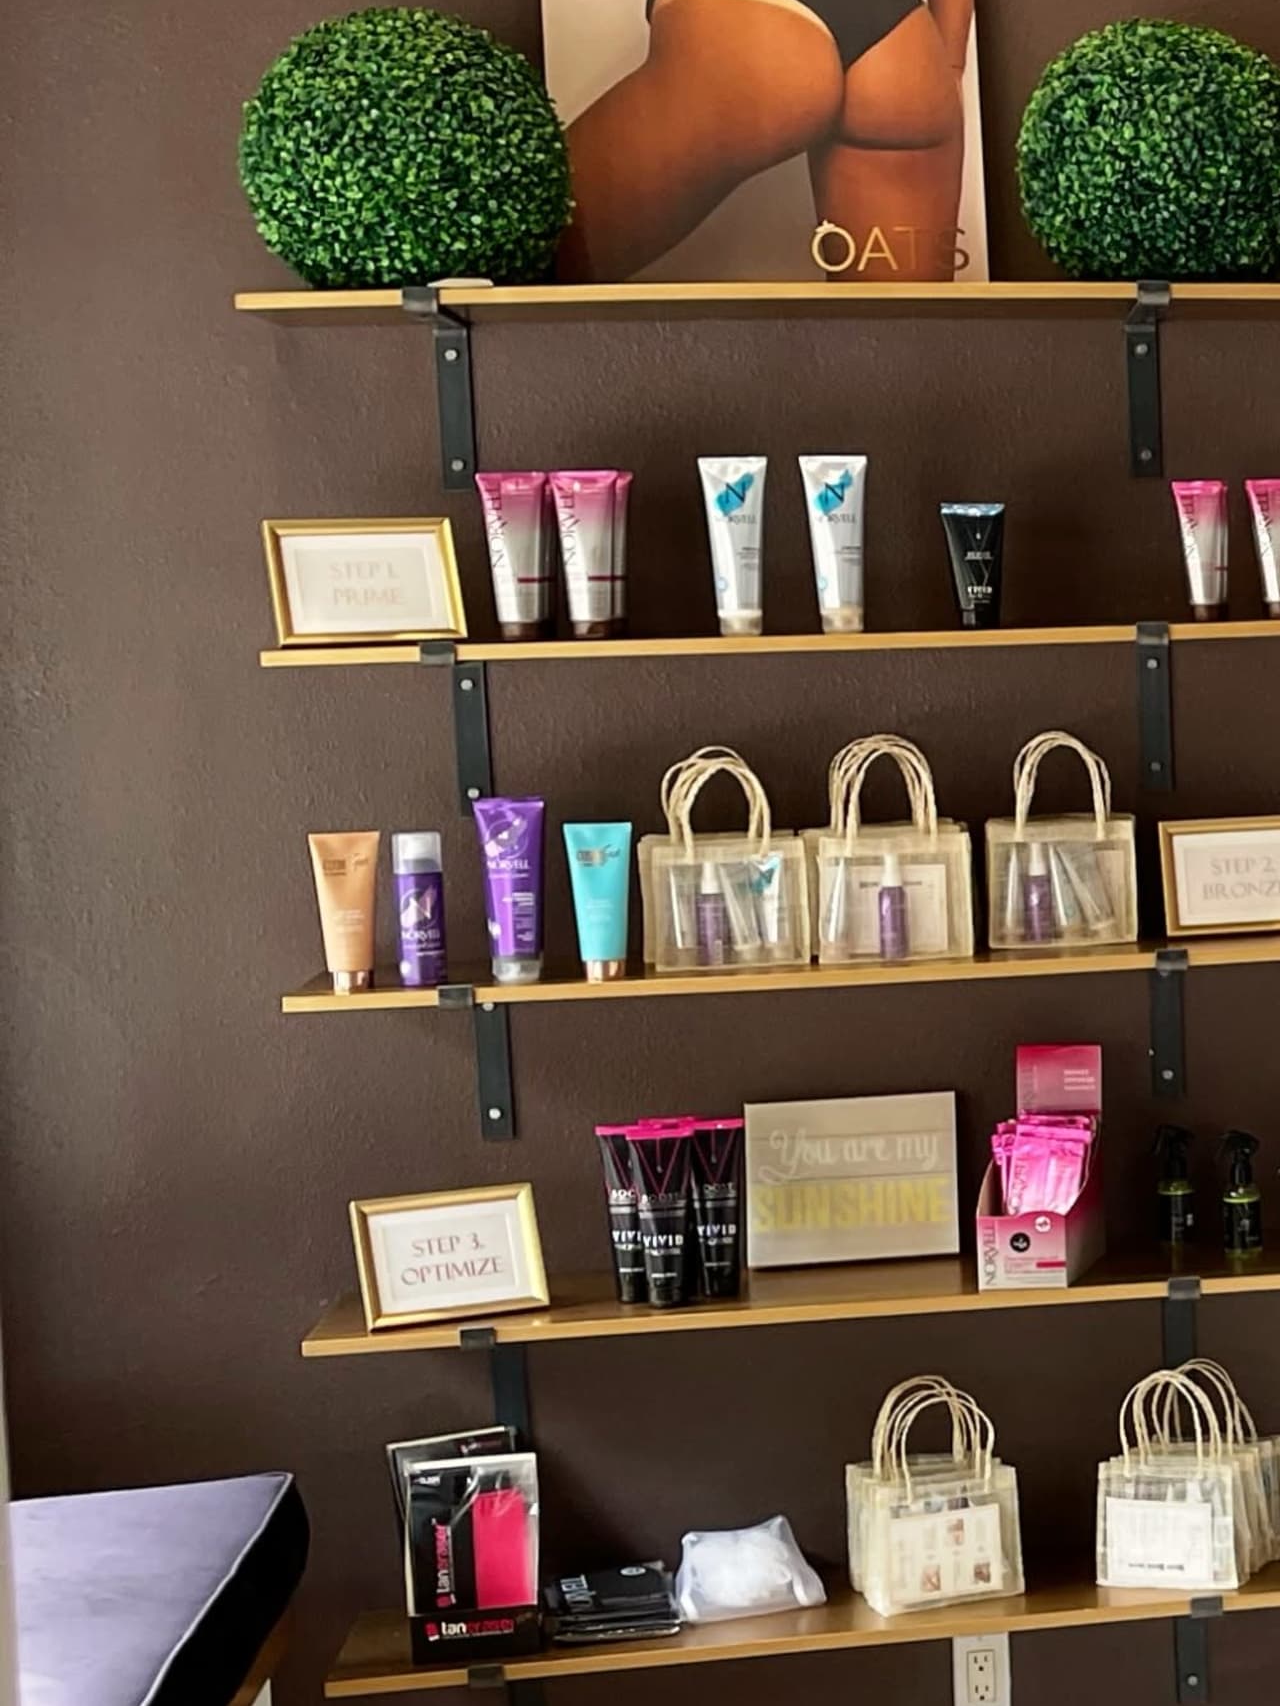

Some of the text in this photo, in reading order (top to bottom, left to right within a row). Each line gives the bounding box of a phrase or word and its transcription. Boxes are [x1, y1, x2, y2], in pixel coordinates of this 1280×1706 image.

[811, 221, 970, 273] OATS
[1209, 856, 1257, 876] STEP
[843, 1138, 889, 1163] are
[896, 1133, 940, 1171] my
[752, 1176, 949, 1234] SUNSHINE
[612, 1230, 642, 1243] VIVI
[642, 1234, 684, 1248] VIVID
[697, 1223, 737, 1236] VIVID
[411, 1234, 461, 1258] STEP
[400, 1255, 504, 1286] OPTIMIZE
